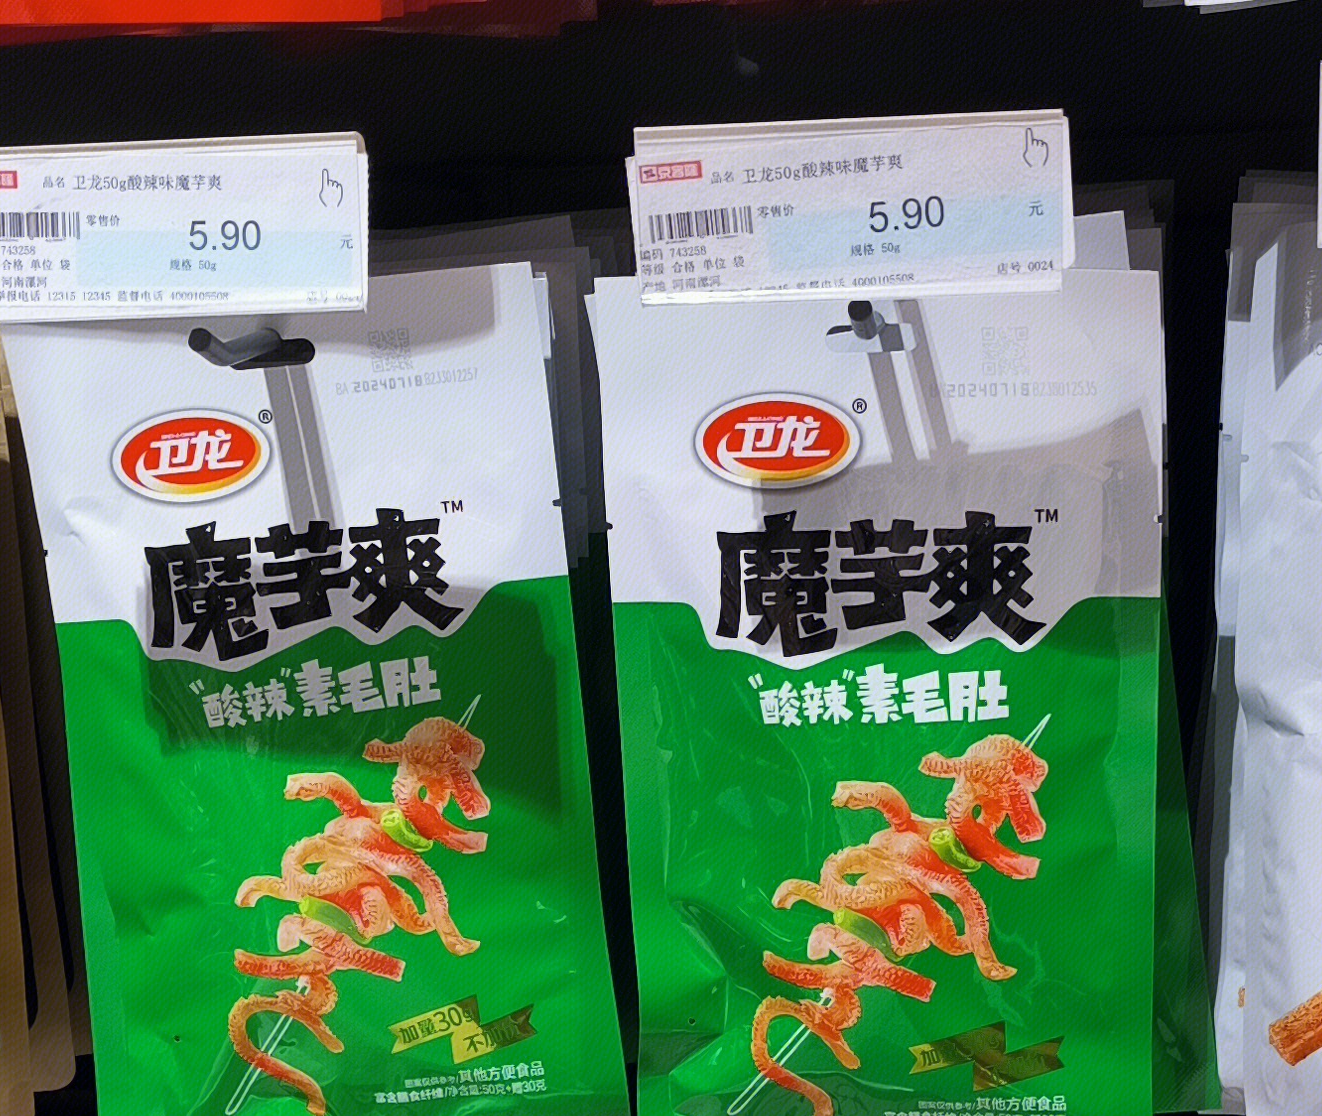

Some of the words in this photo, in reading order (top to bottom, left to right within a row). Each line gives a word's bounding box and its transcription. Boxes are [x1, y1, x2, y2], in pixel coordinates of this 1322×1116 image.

[43, 176, 65, 189] 品名
[72, 173, 222, 192] 卫龙50g酸辣味魔芋爽
[743, 154, 903, 184] 卫龙50g酸辣味魔芋爽
[86, 213, 120, 228] 零售价
[869, 196, 945, 233] 5.90
[1029, 201, 1044, 216] 元
[0, 244, 36, 256] 743258
[188, 219, 261, 251] 5.90
[339, 234, 354, 249] 元
[198, 259, 217, 272] 50g
[149, 428, 245, 475] 卫龙
[734, 415, 831, 458] 卫龙
[144, 508, 465, 662] 魔芋爽
[716, 510, 1047, 658] 魔芋爽
